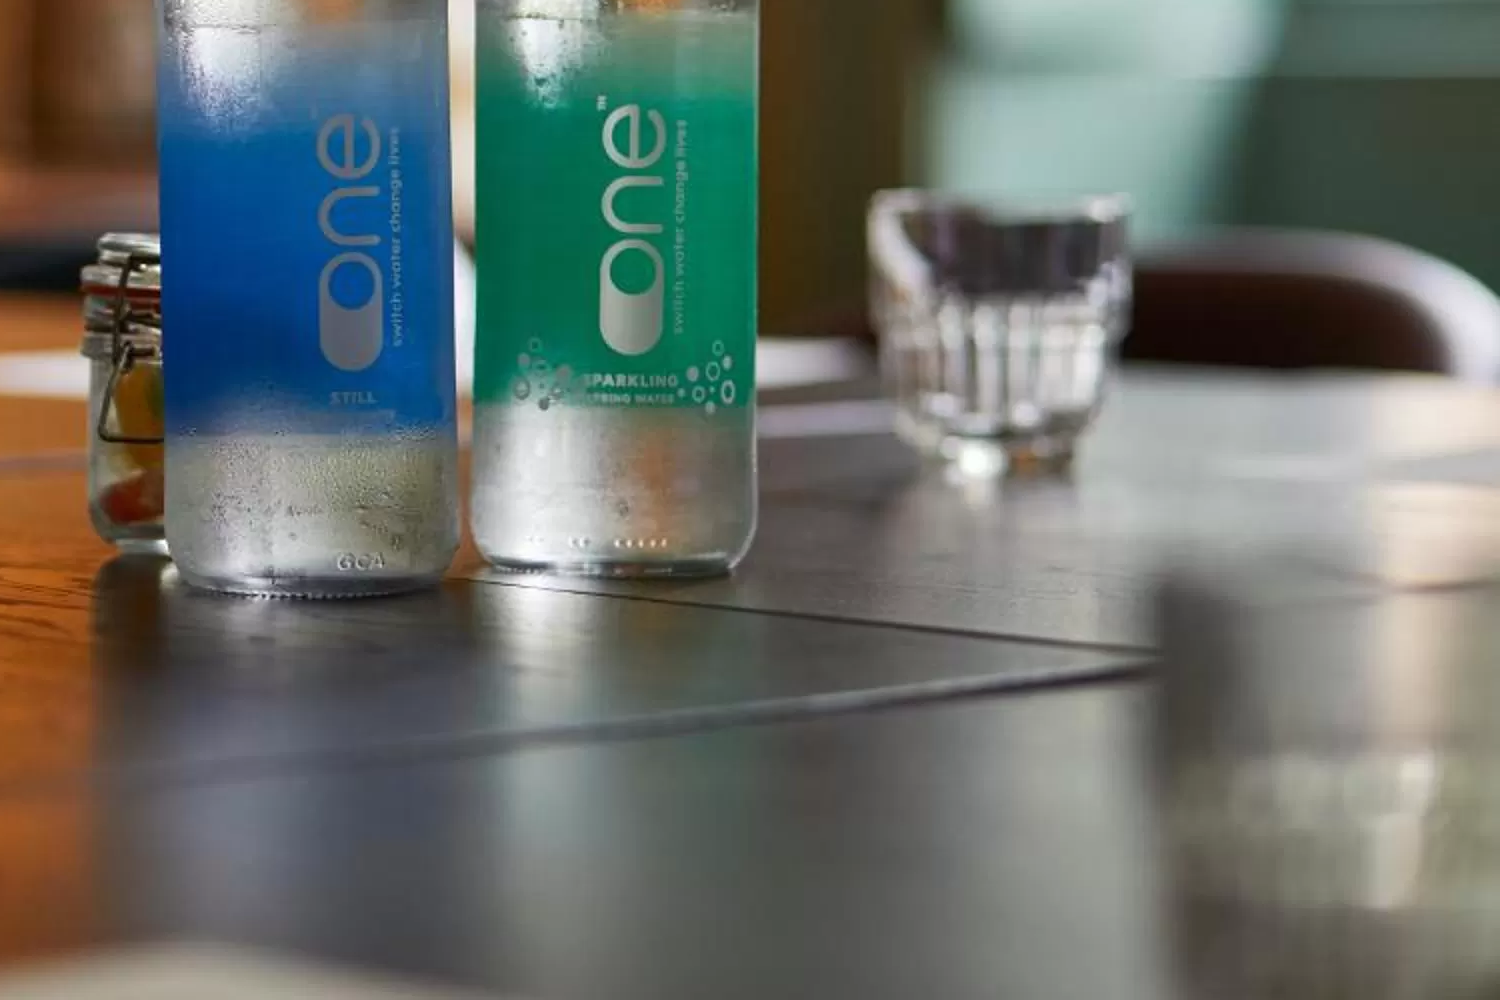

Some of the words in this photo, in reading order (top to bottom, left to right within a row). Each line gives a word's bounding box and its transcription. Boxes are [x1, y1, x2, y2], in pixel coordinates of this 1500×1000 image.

[389, 169, 403, 234] change
[674, 160, 689, 223] change
[316, 112, 384, 372] one
[599, 103, 667, 357] one
[673, 228, 687, 277] water
[389, 238, 402, 289] water
[389, 292, 404, 348] switch
[329, 390, 380, 405] STILL
